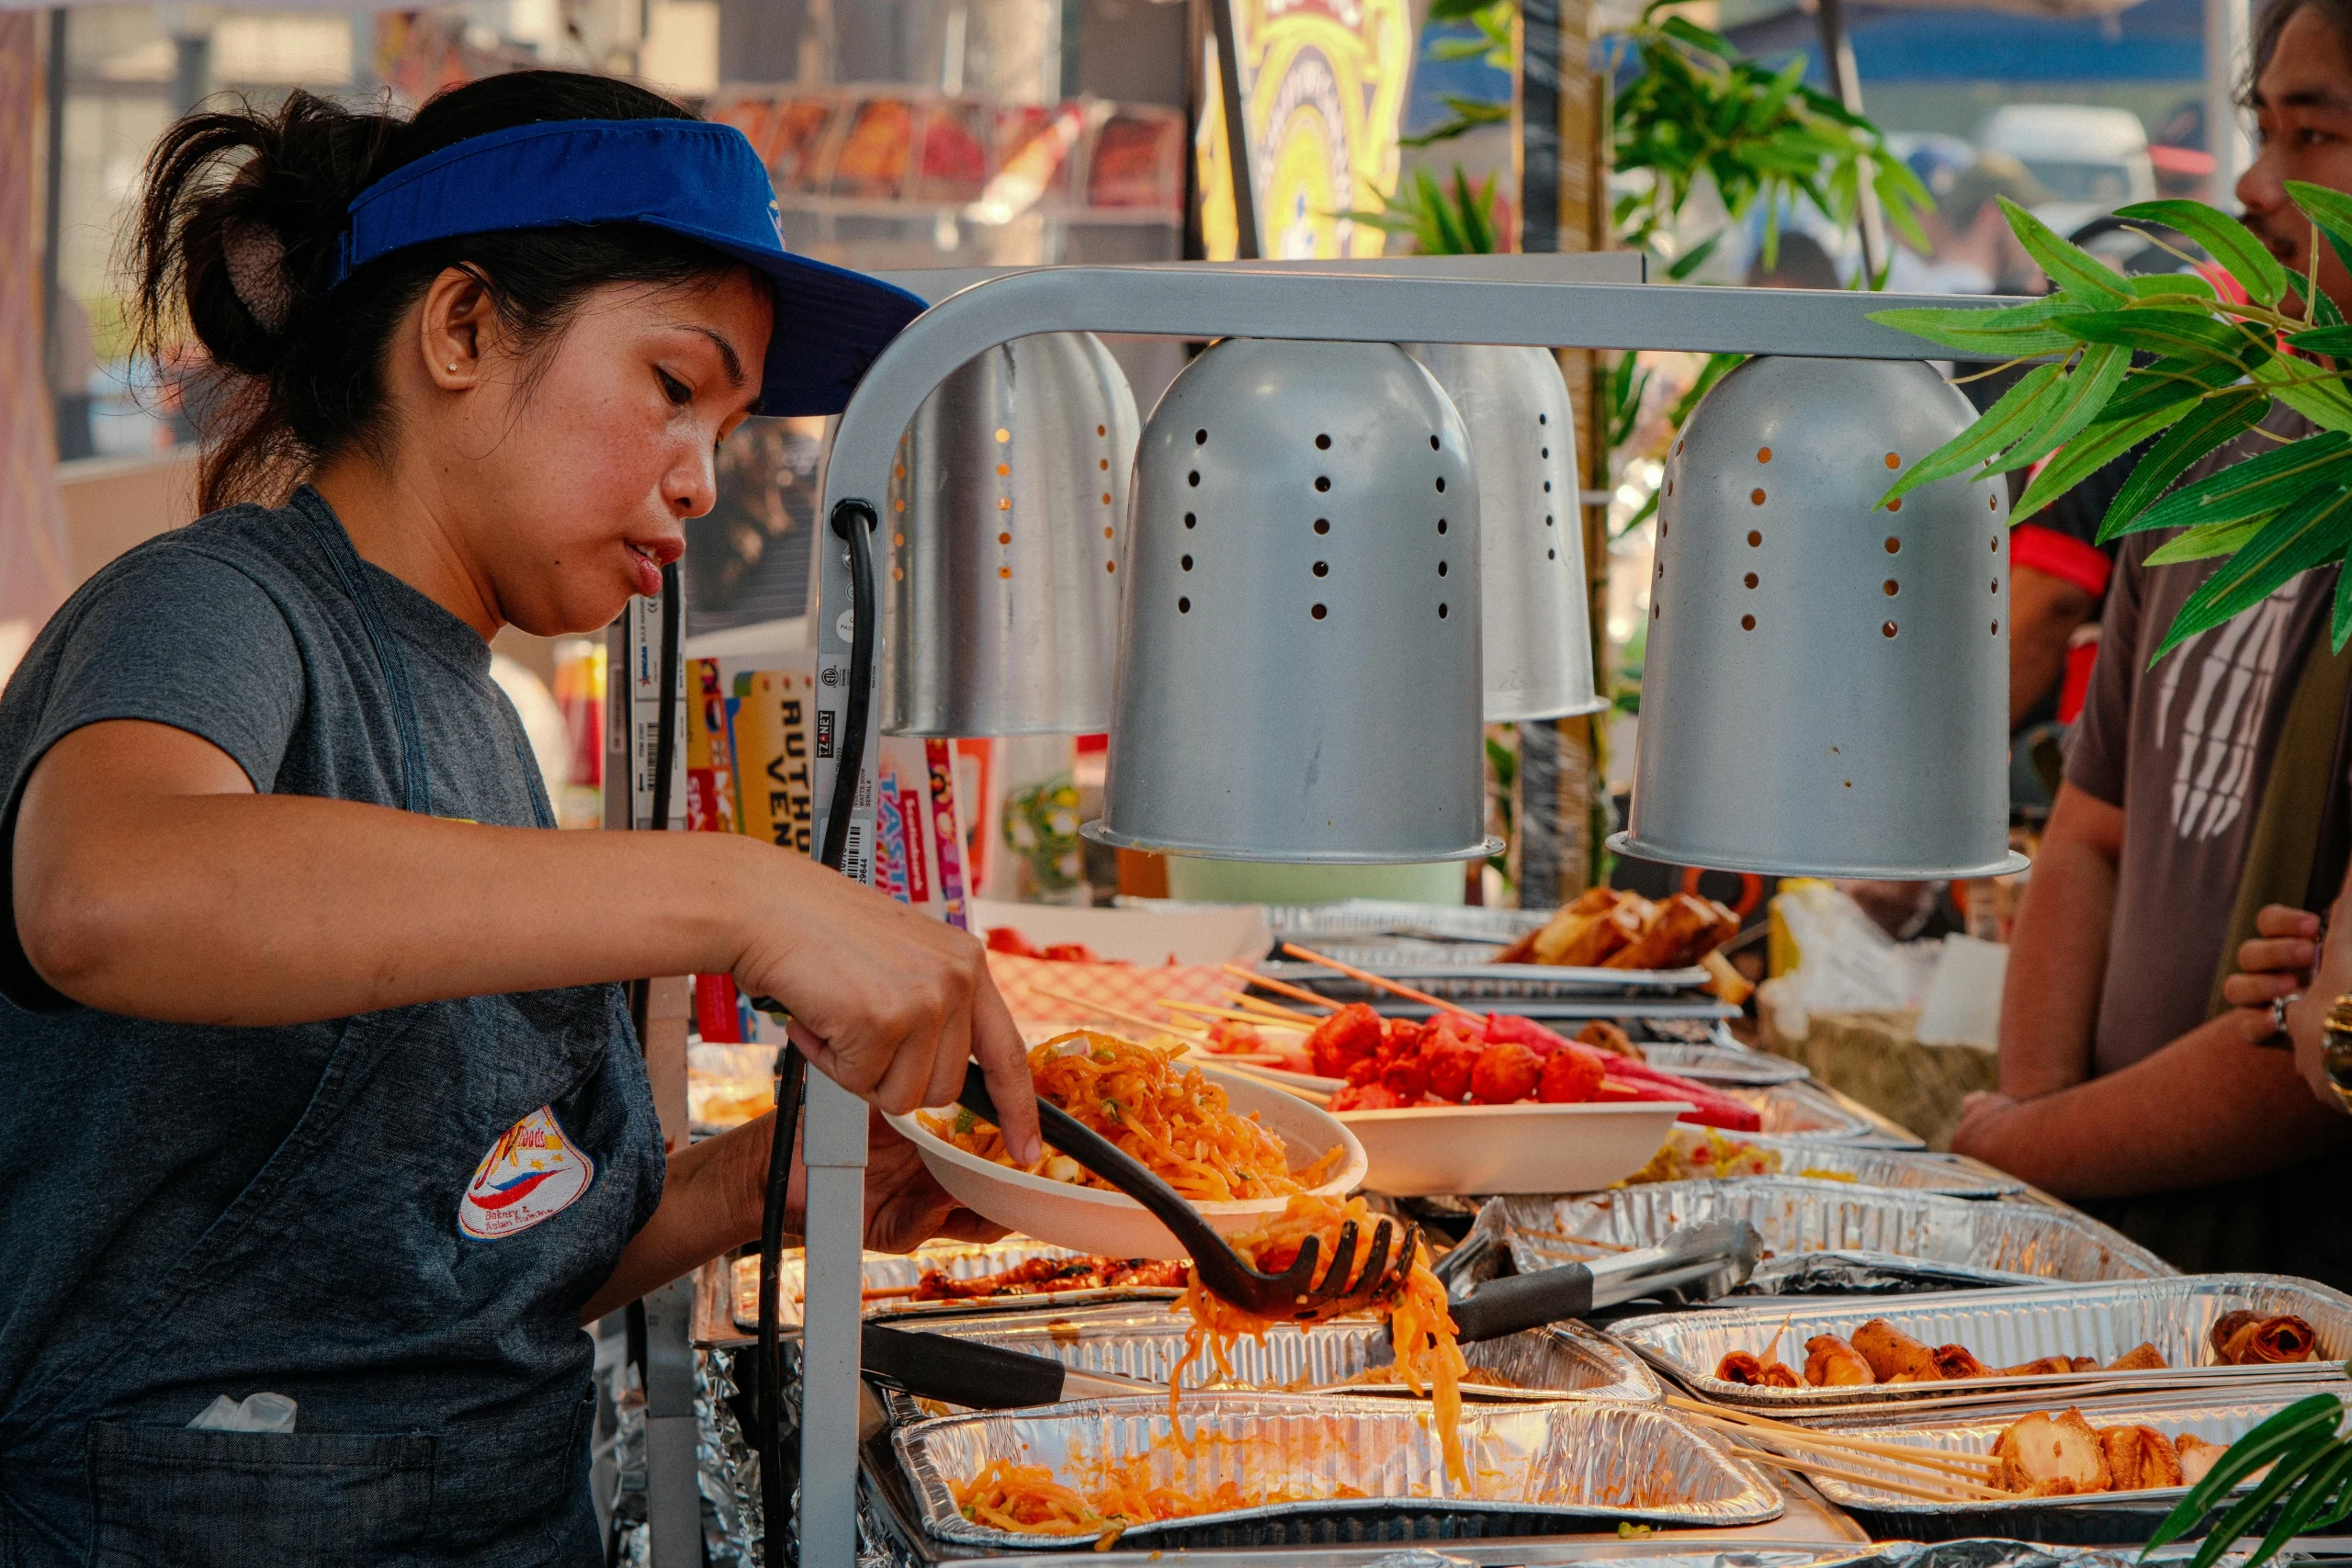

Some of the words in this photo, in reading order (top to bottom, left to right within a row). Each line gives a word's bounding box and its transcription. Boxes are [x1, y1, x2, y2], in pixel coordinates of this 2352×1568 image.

[840, 624, 854, 632] PAS
[904, 798, 923, 891] Scotiabank
[859, 858, 867, 885] 29644
